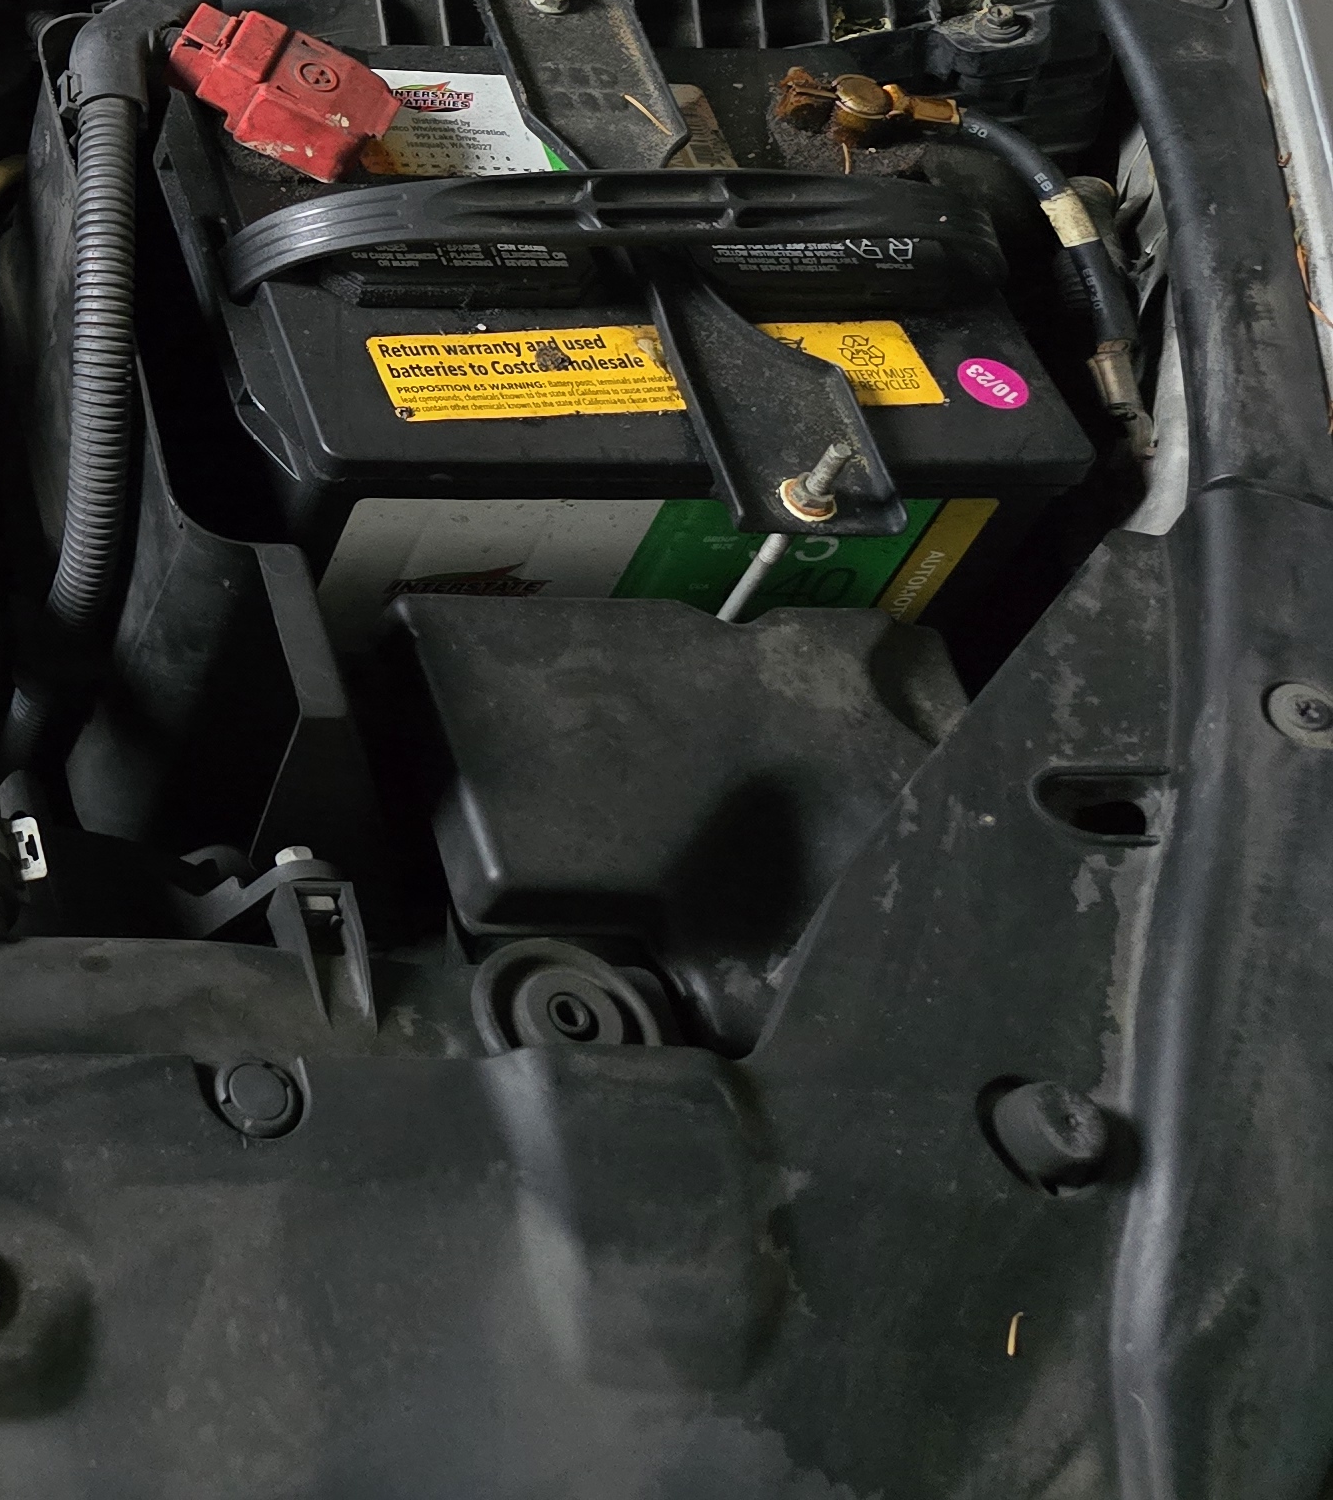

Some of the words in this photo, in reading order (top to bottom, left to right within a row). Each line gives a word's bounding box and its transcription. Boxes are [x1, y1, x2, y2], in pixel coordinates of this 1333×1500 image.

[402, 100, 471, 109] ATTERIES
[411, 117, 459, 126] Distributed
[411, 125, 456, 134] Wholesale
[433, 133, 455, 141] Lake
[1034, 172, 1053, 192] EB
[378, 343, 440, 358] Return
[441, 341, 522, 357] warranty
[562, 334, 607, 350] used
[386, 361, 468, 378] batteries
[468, 363, 489, 376] to
[491, 359, 548, 376] Costc
[845, 368, 882, 382] TTERY
[882, 366, 919, 379] MUST
[396, 384, 471, 394] PROPOSITION
[489, 380, 547, 391] WARNING:
[548, 380, 573, 391] Battery
[575, 379, 597, 388] posts,
[598, 377, 630, 386] terminals
[632, 375, 646, 384] and
[858, 378, 921, 392] RECYCLED
[966, 363, 1019, 406] 10/23
[418, 393, 464, 404] compounds,
[464, 392, 500, 401] chemicals
[500, 391, 525, 400] known
[527, 391, 534, 399] to
[535, 390, 547, 399] the
[548, 390, 566, 398] state
[567, 389, 575, 397] of
[577, 387, 611, 397] California
[612, 387, 619, 395] to
[622, 387, 641, 395] cause
[642, 385, 665, 393] cancer
[422, 404, 449, 412] contain
[450, 403, 470, 411] other
[470, 402, 505, 410] chemicals
[506, 401, 531, 409] known
[555, 399, 573, 407] state
[575, 398, 583, 406] of
[583, 396, 618, 406] California
[618, 397, 625, 405] to
[627, 396, 647, 404] cause
[386, 580, 542, 597] INTERSTATE
